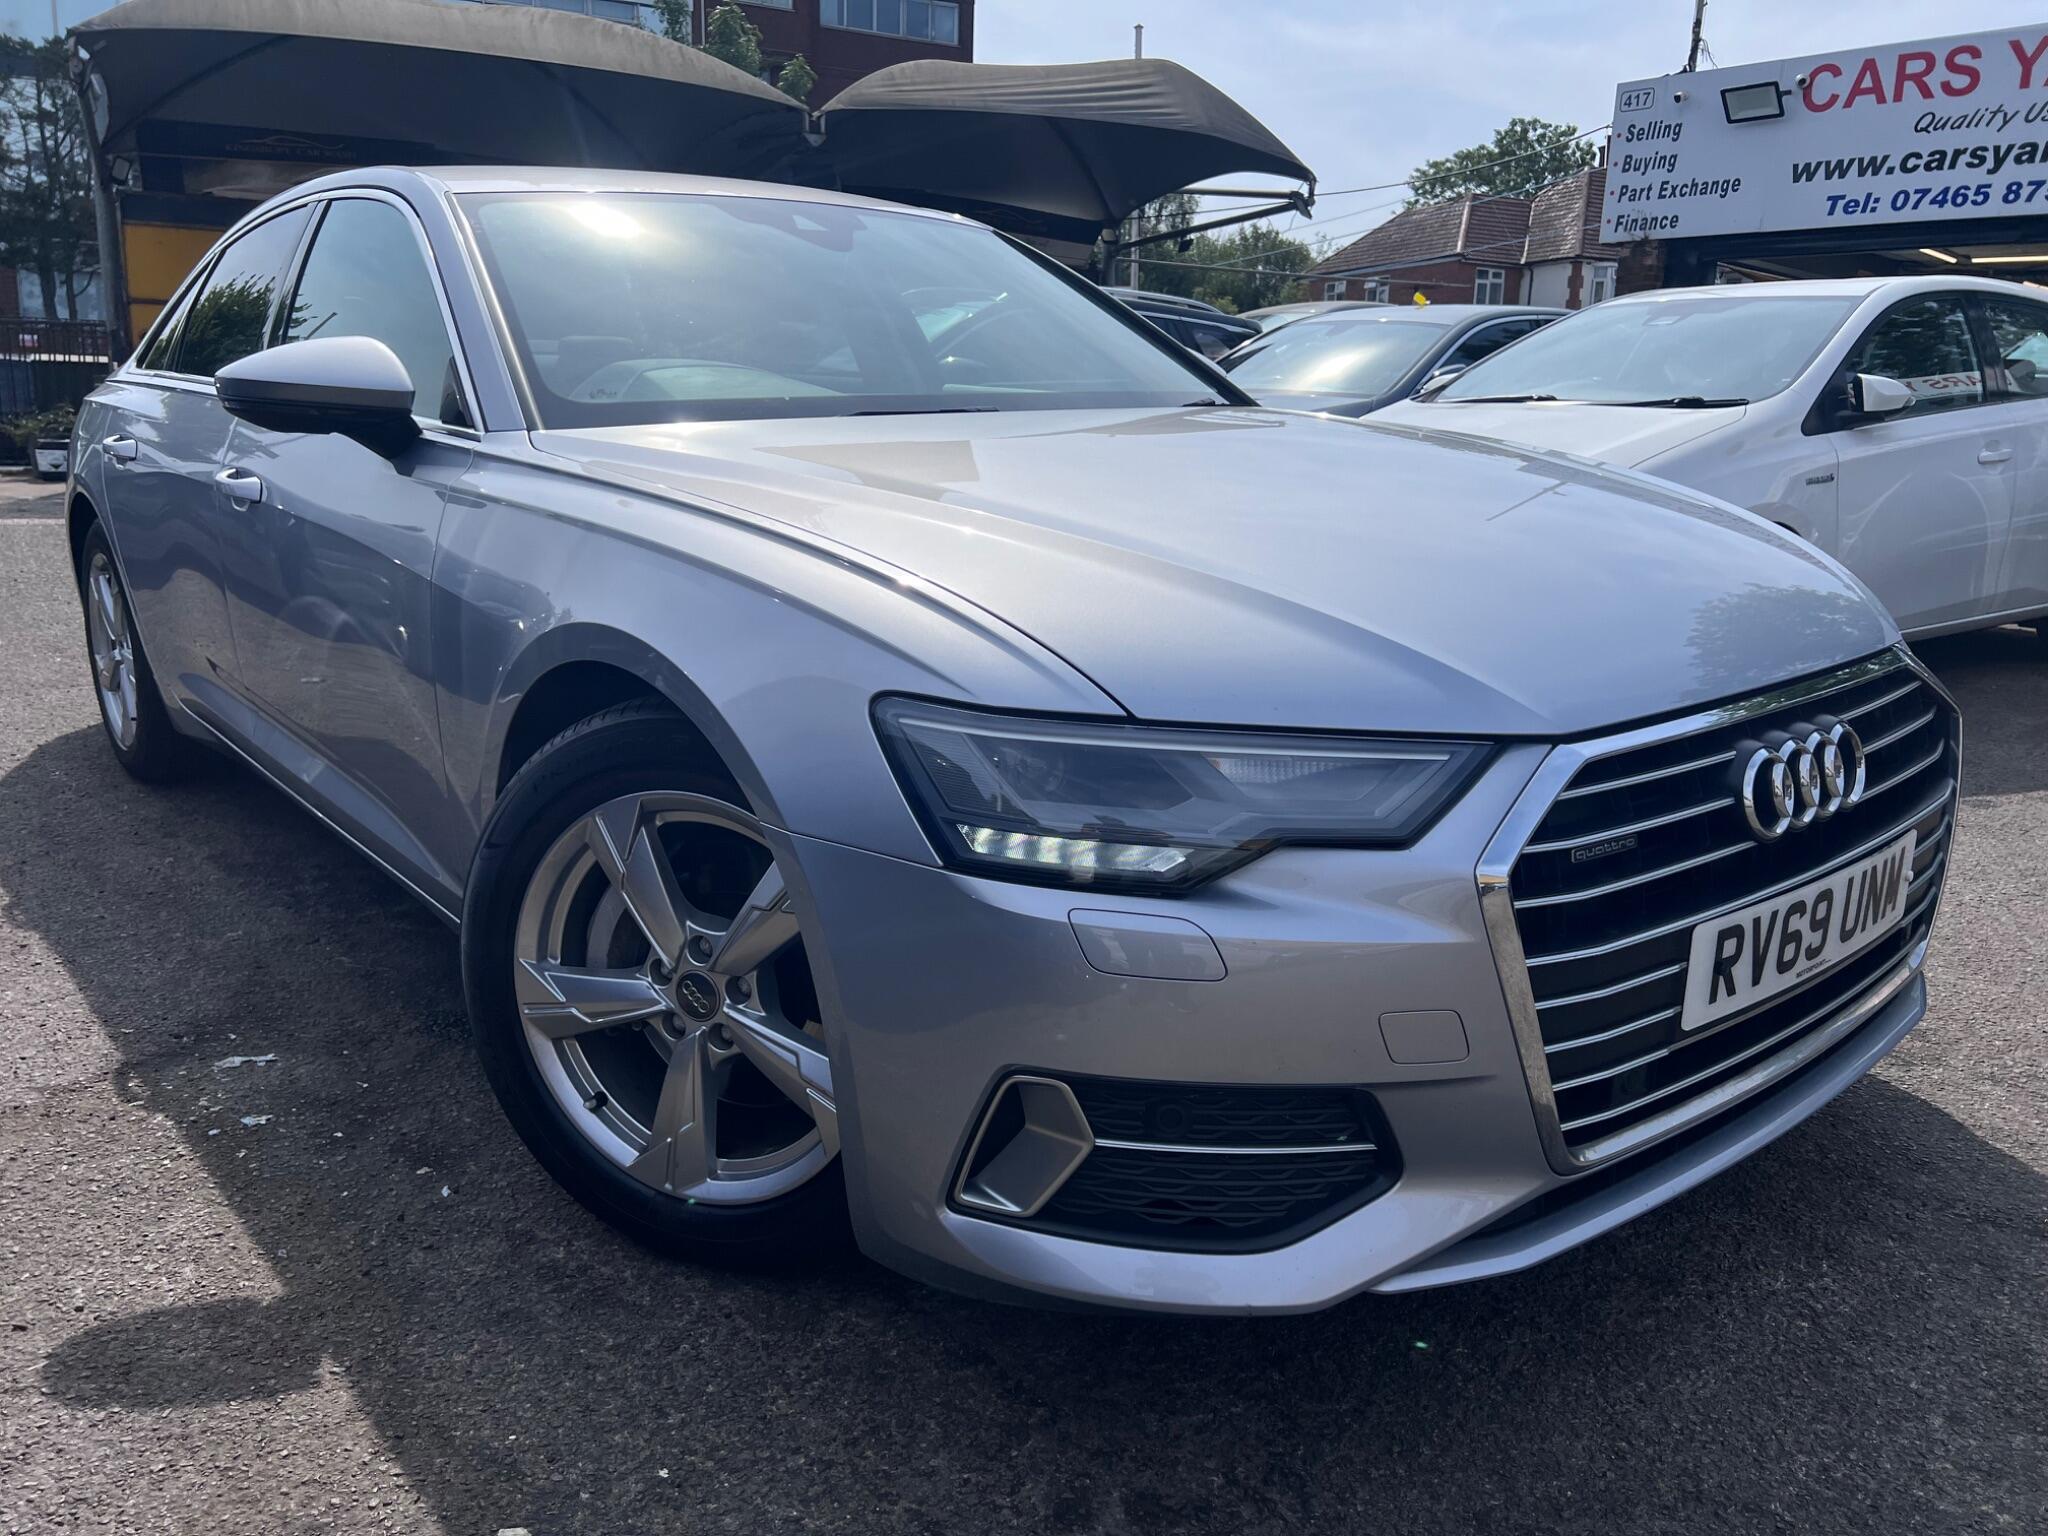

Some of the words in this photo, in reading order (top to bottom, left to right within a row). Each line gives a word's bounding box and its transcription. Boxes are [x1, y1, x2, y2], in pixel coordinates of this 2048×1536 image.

[1802, 44, 1983, 113] CARS
[2008, 33, 2048, 90] Y
[1623, 91, 1651, 108] 417
[1625, 119, 1683, 143] Selling
[1913, 104, 2020, 134] Quality
[1621, 151, 1678, 176] Buying
[1617, 180, 1652, 203] Part
[1657, 177, 1741, 199] Exchange
[1826, 192, 1881, 216] Tel:
[1890, 183, 1992, 212] 07465
[1614, 213, 1679, 233] Finance
[1575, 838, 1636, 860] quattro
[1708, 887, 1833, 1005] RV69
